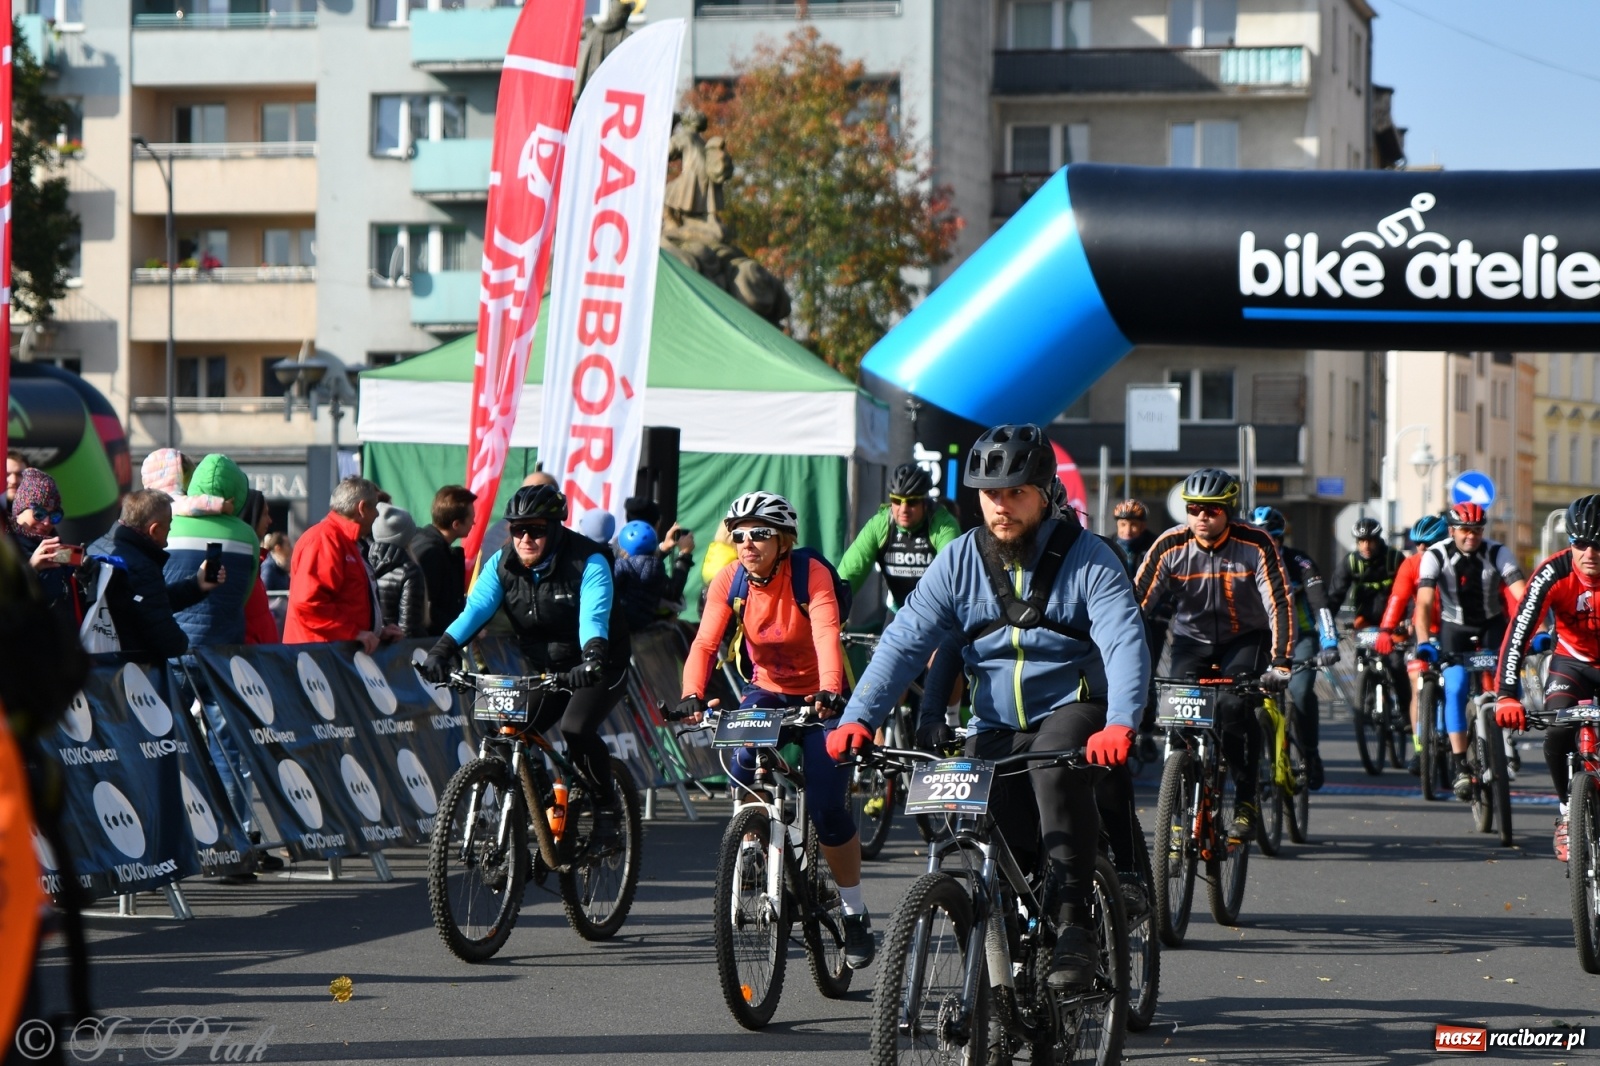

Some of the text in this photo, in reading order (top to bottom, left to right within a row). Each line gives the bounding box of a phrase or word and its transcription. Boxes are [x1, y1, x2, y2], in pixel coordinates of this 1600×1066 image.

[1239, 231, 1600, 300] bike atelie
[564, 89, 644, 526] RACIBÓRZ
[895, 552, 934, 565] BORA
[1505, 563, 1555, 685] opony-serafinowski.pl
[487, 697, 514, 711] 138
[1168, 697, 1207, 706] OPIEKUN
[1174, 705, 1201, 719] 101
[312, 724, 356, 740] KOKOwear
[371, 719, 415, 736] KOKOwear
[727, 720, 772, 729] OPIEKUN
[249, 727, 296, 745] KOKOwear
[60, 746, 119, 766] KOKOwear
[922, 773, 979, 784] OPIEKUN
[927, 783, 971, 801] 220
[300, 833, 346, 850] KOKOwear
[361, 825, 404, 842] KOKOwear
[200, 849, 241, 867] OKOwear
[114, 858, 179, 883] KOKOwear
